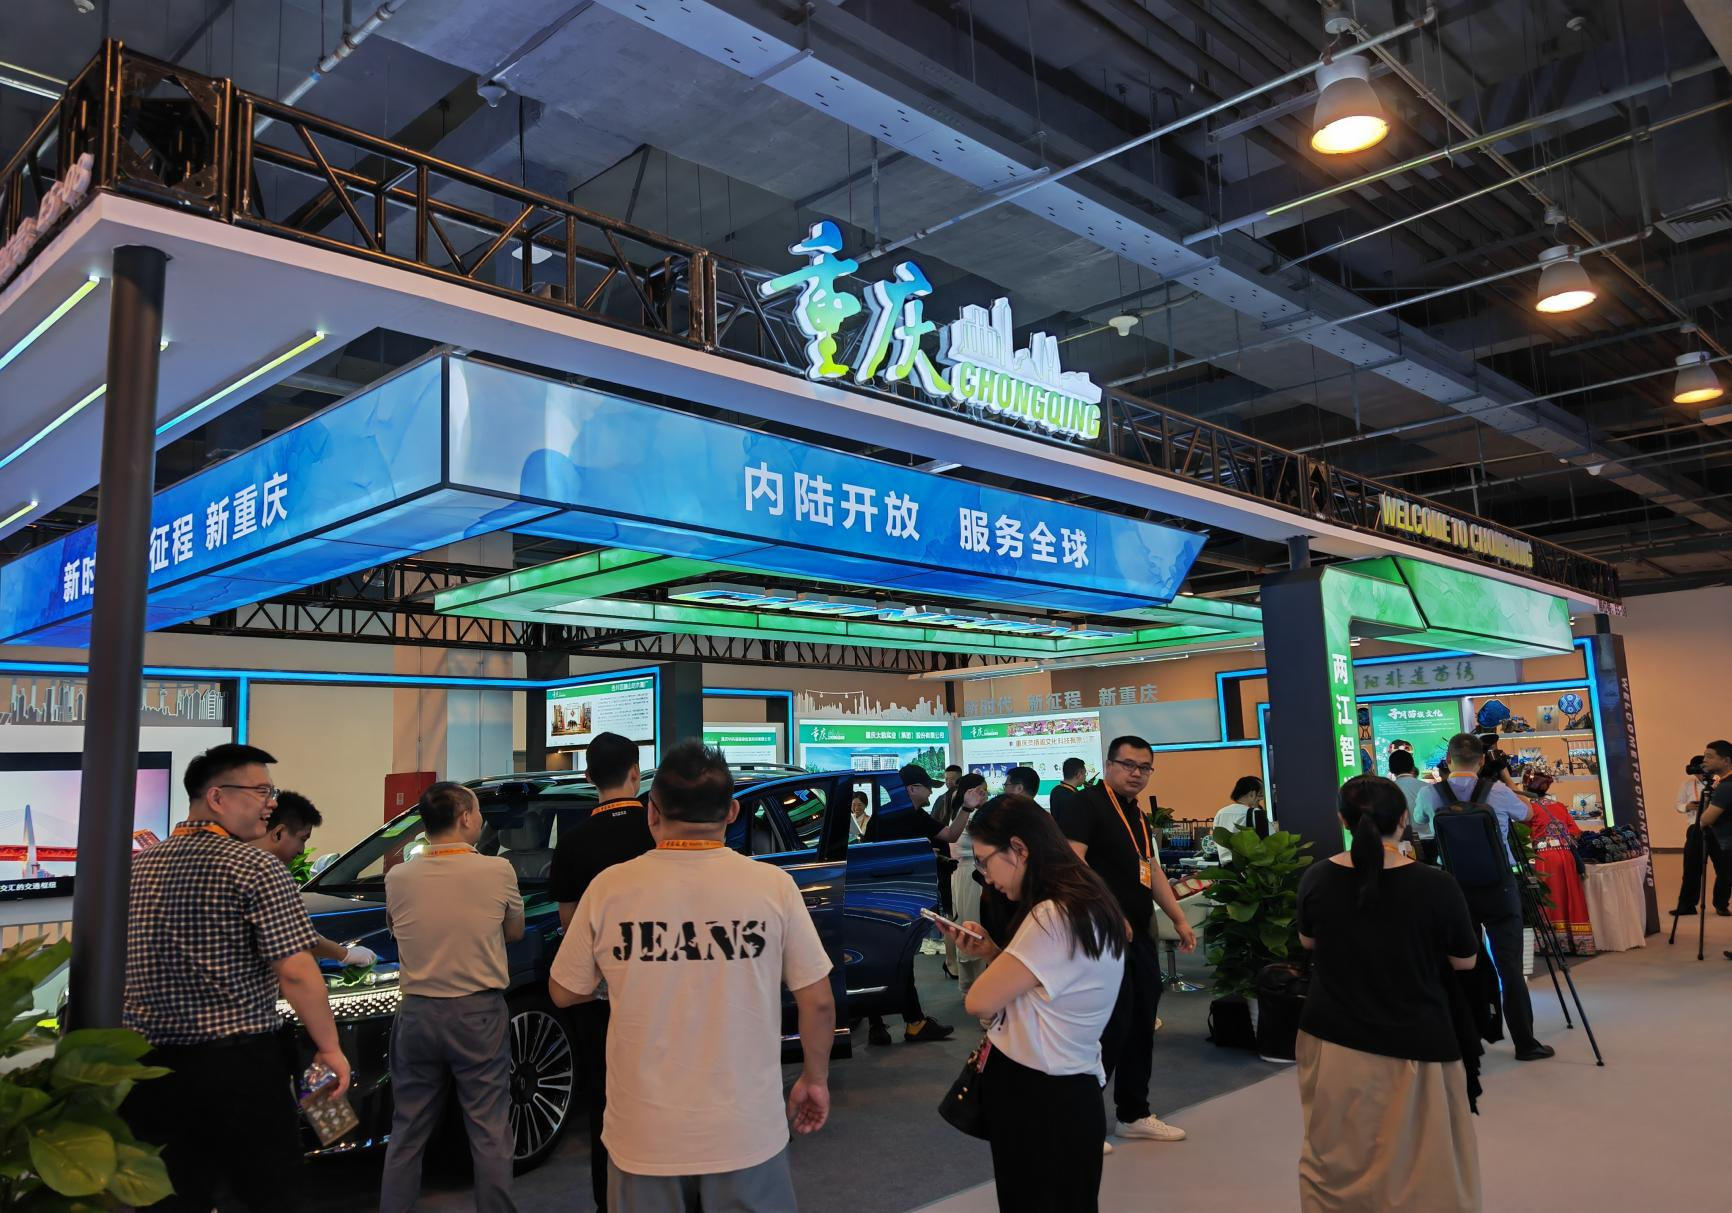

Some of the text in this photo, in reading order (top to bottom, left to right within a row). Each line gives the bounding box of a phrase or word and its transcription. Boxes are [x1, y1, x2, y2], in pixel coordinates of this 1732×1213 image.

[758, 220, 953, 398] 重庆
[957, 361, 1102, 439] CHONGQING
[63, 472, 288, 602] 新时 征程 新重庆
[744, 461, 1090, 569] 内陆开放 服务全球
[1380, 494, 1451, 543] WELCOME
[1450, 517, 1469, 549] TO
[1027, 690, 1083, 712] 新征程
[1099, 684, 1160, 706] 新重庆
[1332, 653, 1355, 782] 两江智
[612, 920, 767, 962] JEANS
